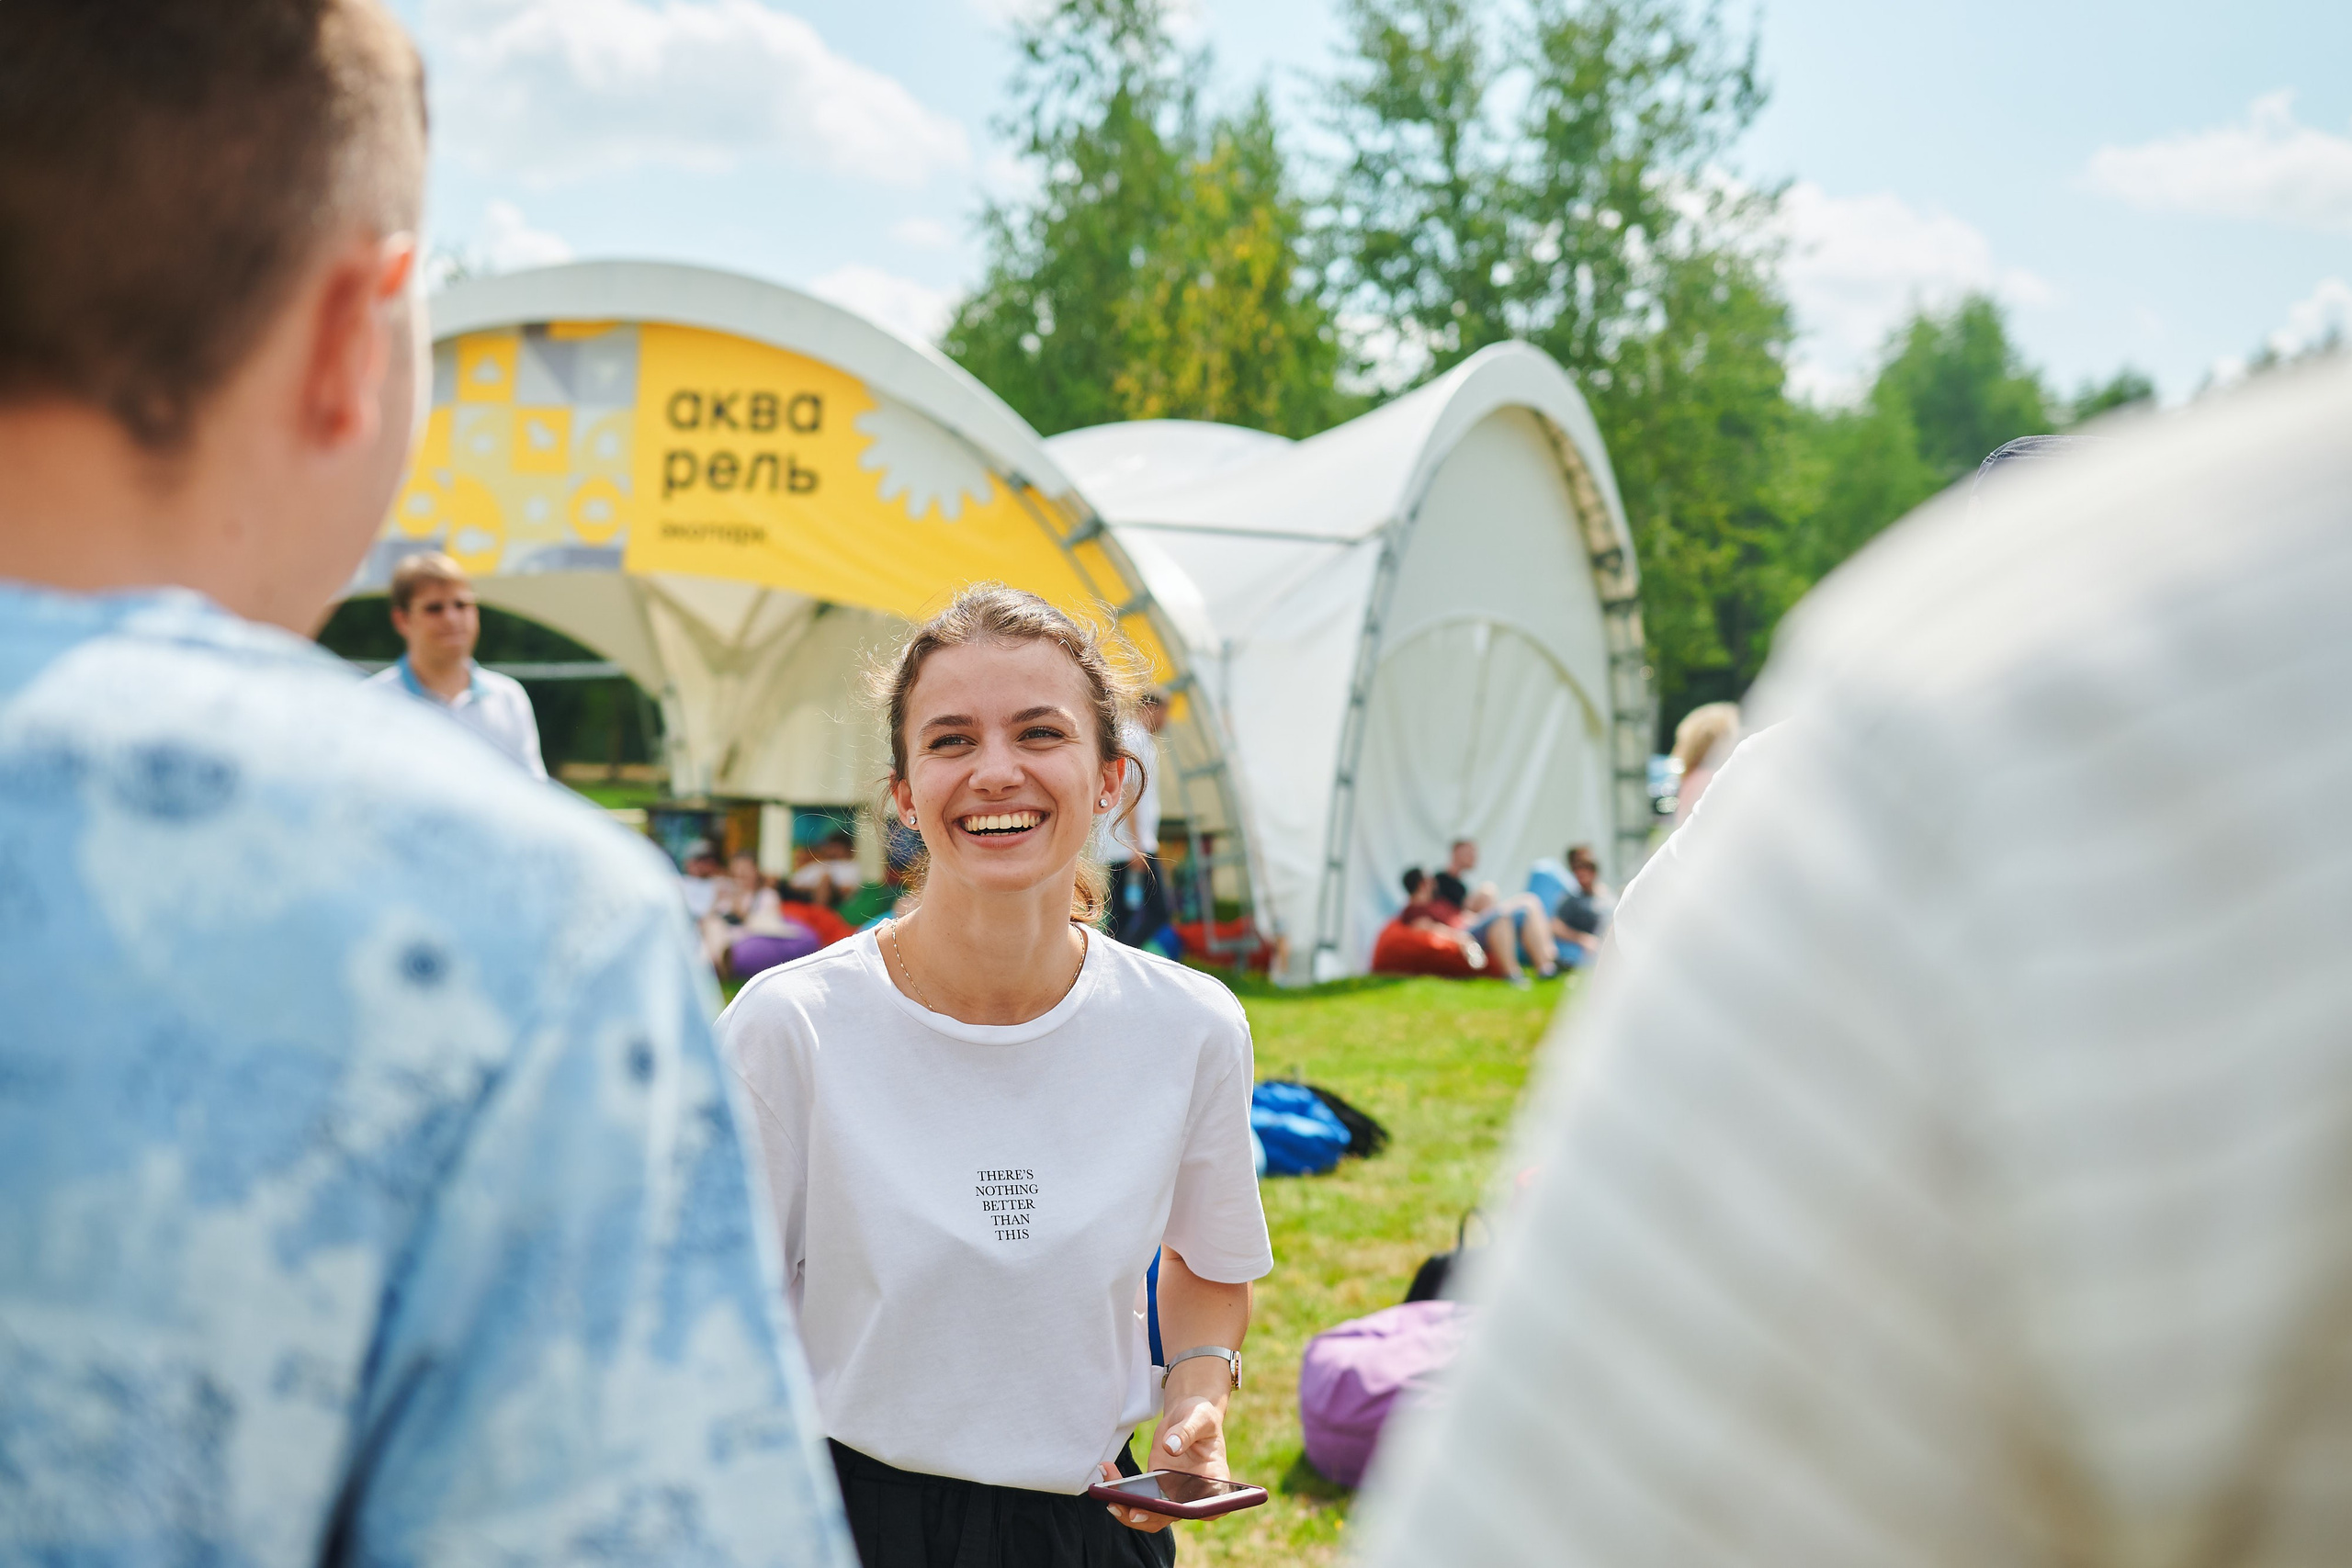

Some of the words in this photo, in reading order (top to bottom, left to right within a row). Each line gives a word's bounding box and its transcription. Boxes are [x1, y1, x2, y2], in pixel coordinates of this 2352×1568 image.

[666, 389, 822, 434] аква
[662, 449, 820, 499] рель
[977, 1169, 1035, 1181] THERE'S
[975, 1184, 1039, 1196] NOTHING
[982, 1199, 1035, 1211] BETTER
[990, 1213, 1030, 1225] THAN
[995, 1229, 1030, 1240] THIS
